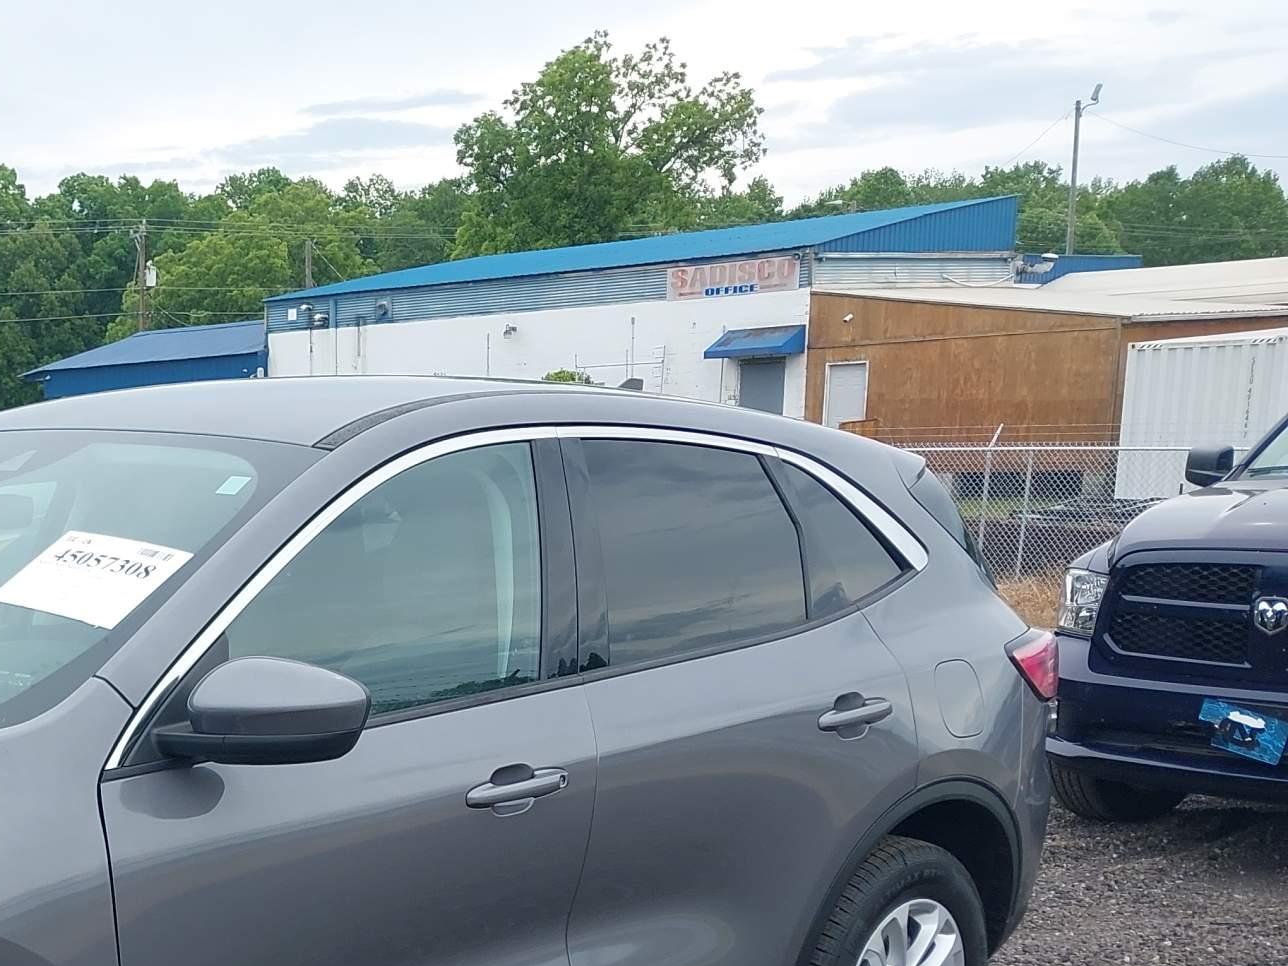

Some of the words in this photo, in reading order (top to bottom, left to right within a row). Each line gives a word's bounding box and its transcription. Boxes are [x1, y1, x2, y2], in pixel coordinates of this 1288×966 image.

[671, 259, 796, 289] SADISCO
[704, 284, 759, 297] OFFICE
[54, 548, 157, 579] 45057308
